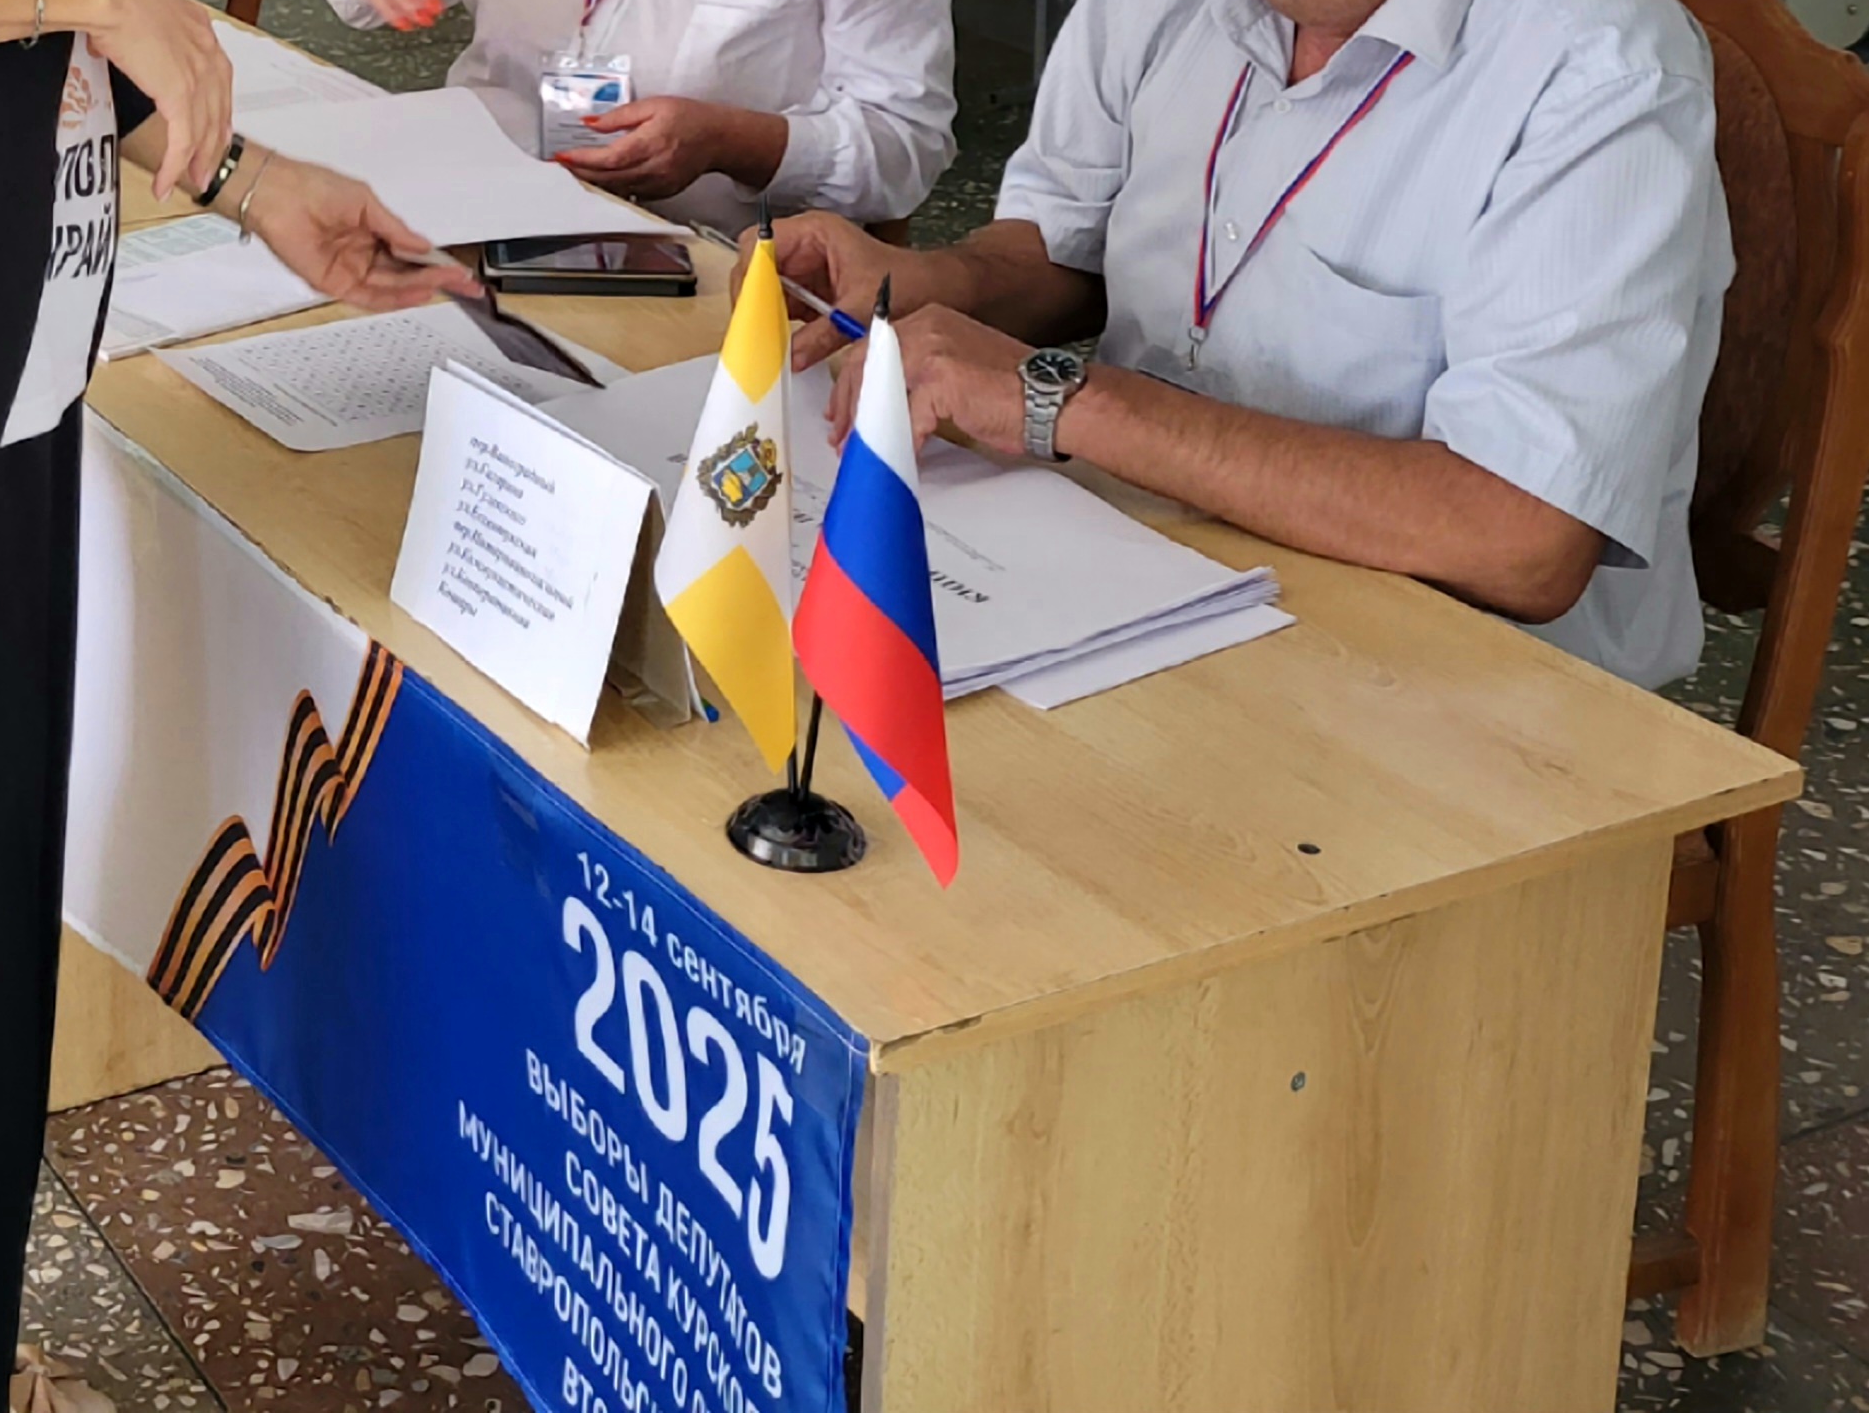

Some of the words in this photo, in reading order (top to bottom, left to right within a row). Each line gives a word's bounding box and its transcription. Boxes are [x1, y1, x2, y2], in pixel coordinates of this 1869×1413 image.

[562, 895, 794, 1280] 2025
[577, 851, 658, 947] 12-14
[666, 932, 806, 1077] сентября
[458, 1099, 688, 1409] МУНИЦИПАЛЬНОГО
[485, 1191, 657, 1413] СТАВРОПОЛЬС
[526, 1047, 649, 1203] ВЫБОРЫ
[655, 1178, 782, 1399] ДЕПУТАТОВ
[566, 1149, 661, 1294] СОВЕТА
